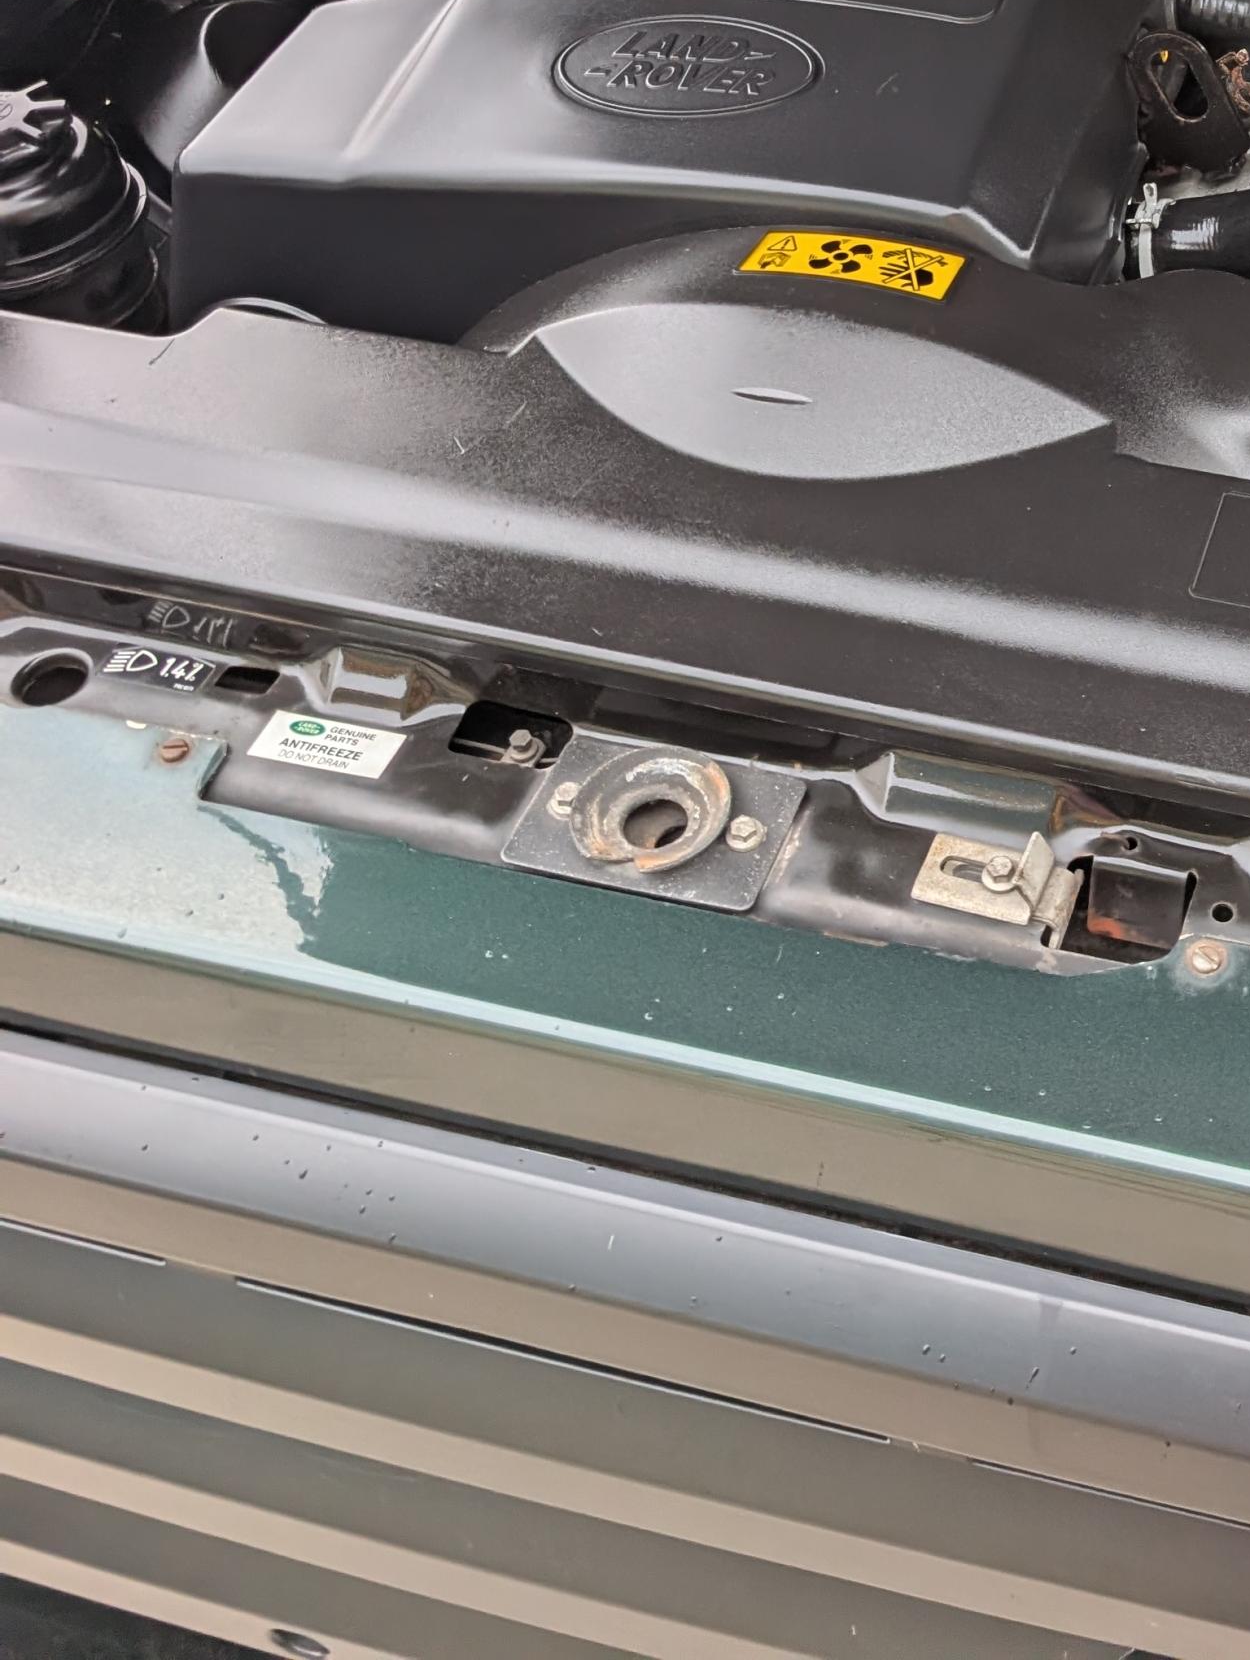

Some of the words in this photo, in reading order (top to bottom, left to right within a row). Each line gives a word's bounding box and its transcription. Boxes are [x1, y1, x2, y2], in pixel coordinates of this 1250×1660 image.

[611, 30, 750, 62] LAND
[607, 60, 777, 96] ROVER
[324, 734, 360, 746] PARTS
[330, 726, 377, 742] GENUINE
[278, 748, 294, 758] DO
[294, 752, 317, 764] NOT
[317, 755, 350, 769] DRAIN
[279, 737, 364, 761] ANTIFREEZE
